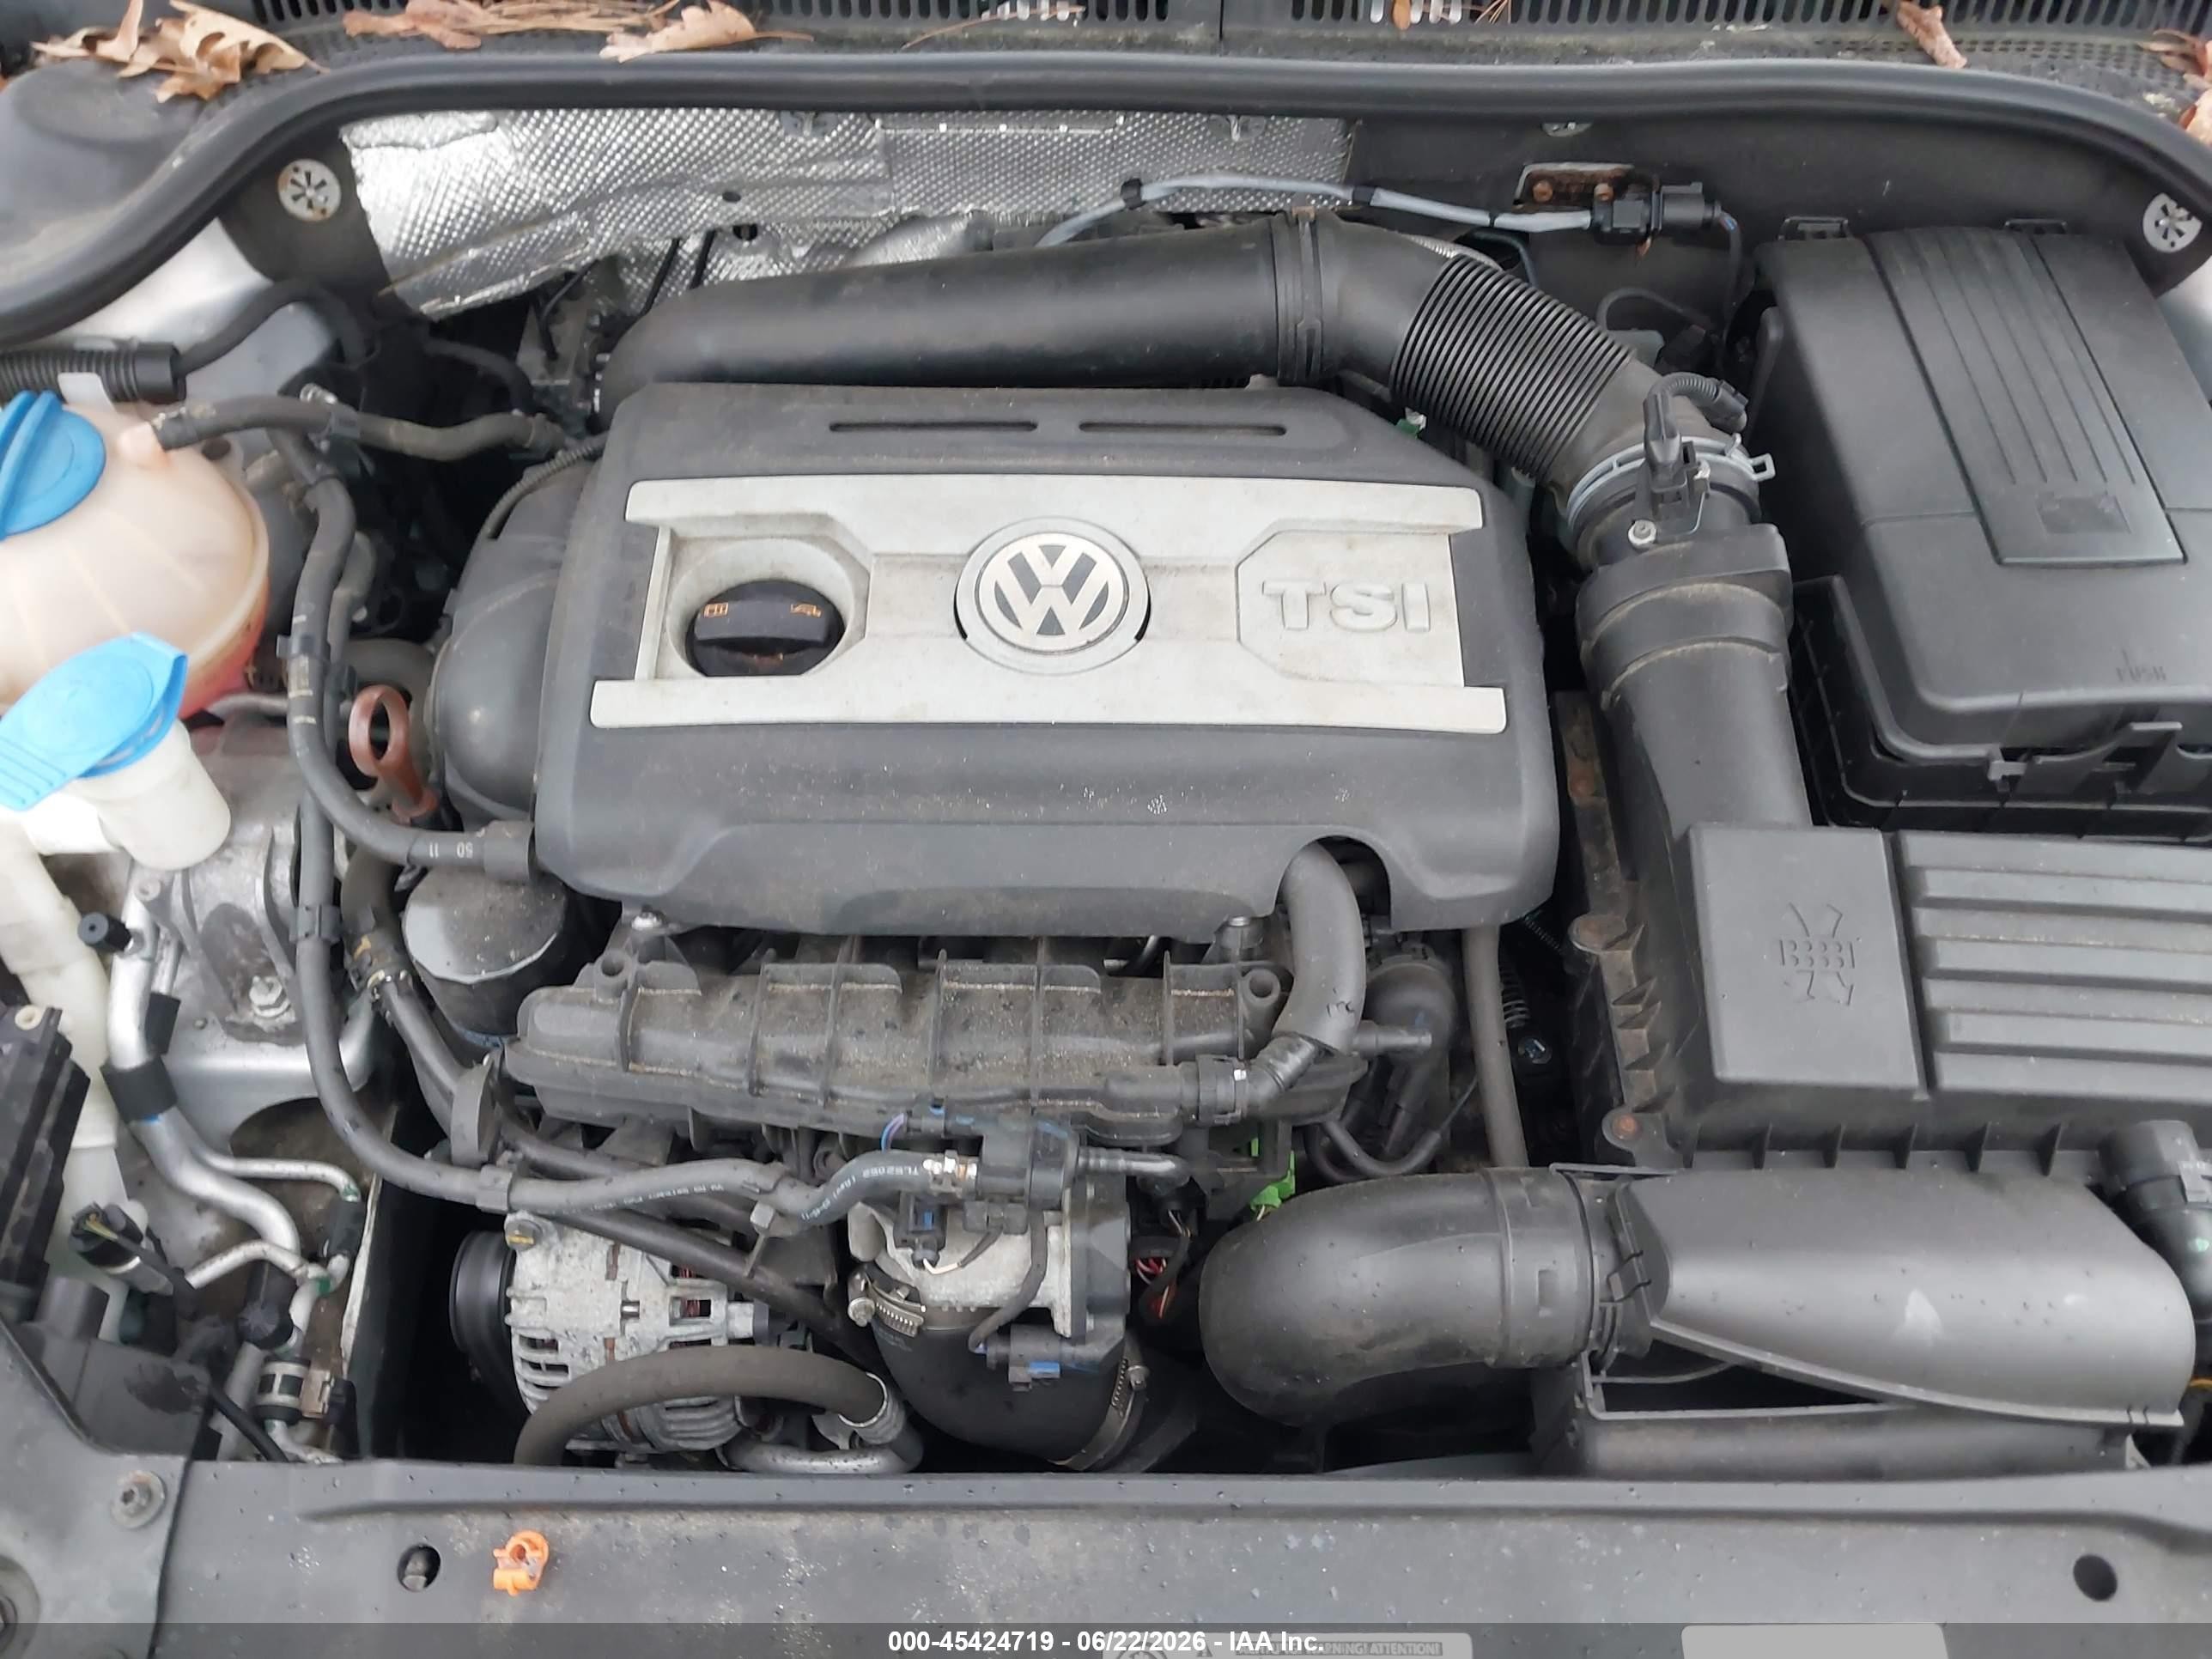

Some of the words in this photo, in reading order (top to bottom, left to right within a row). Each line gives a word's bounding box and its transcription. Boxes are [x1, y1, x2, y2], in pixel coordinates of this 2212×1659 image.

[979, 532, 1125, 651] VW
[1261, 580, 1431, 632] TSI
[1370, 1642, 1440, 1656] ATTENTION!
